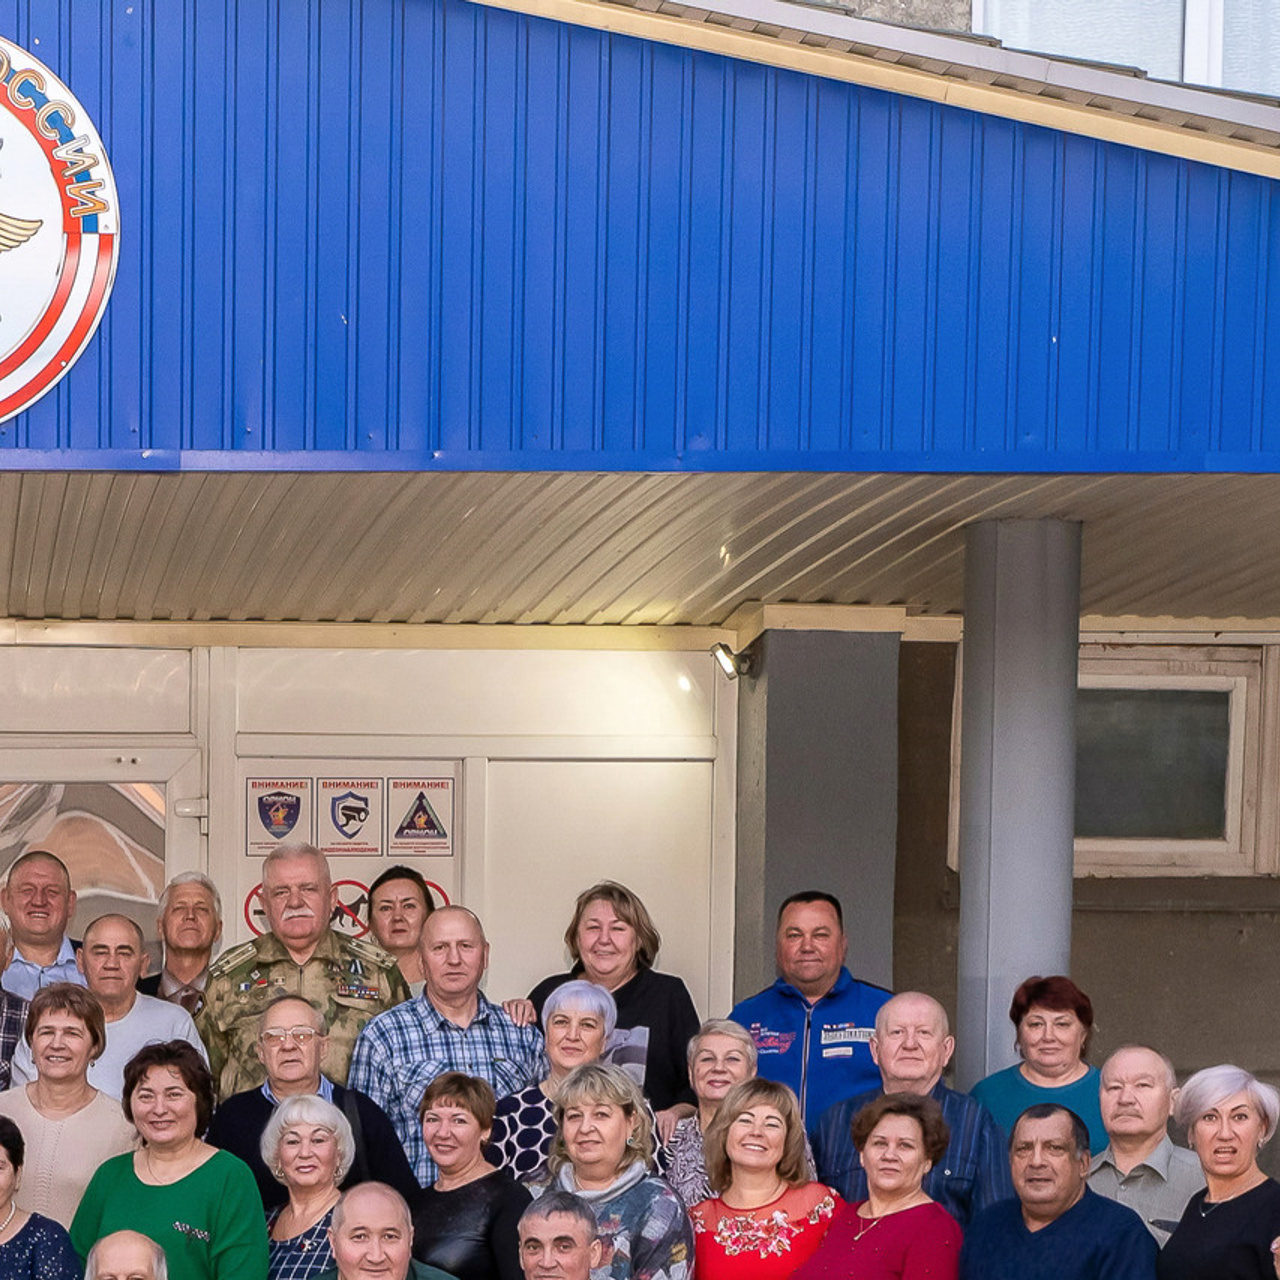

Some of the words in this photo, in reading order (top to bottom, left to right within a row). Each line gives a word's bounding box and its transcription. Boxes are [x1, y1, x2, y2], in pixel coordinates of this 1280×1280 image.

[252, 781, 308, 789] ВНИМАНИЕ!
[322, 781, 379, 789] ВНИМАНИЕ!
[392, 781, 449, 789] ВНИМАНИЕ!
